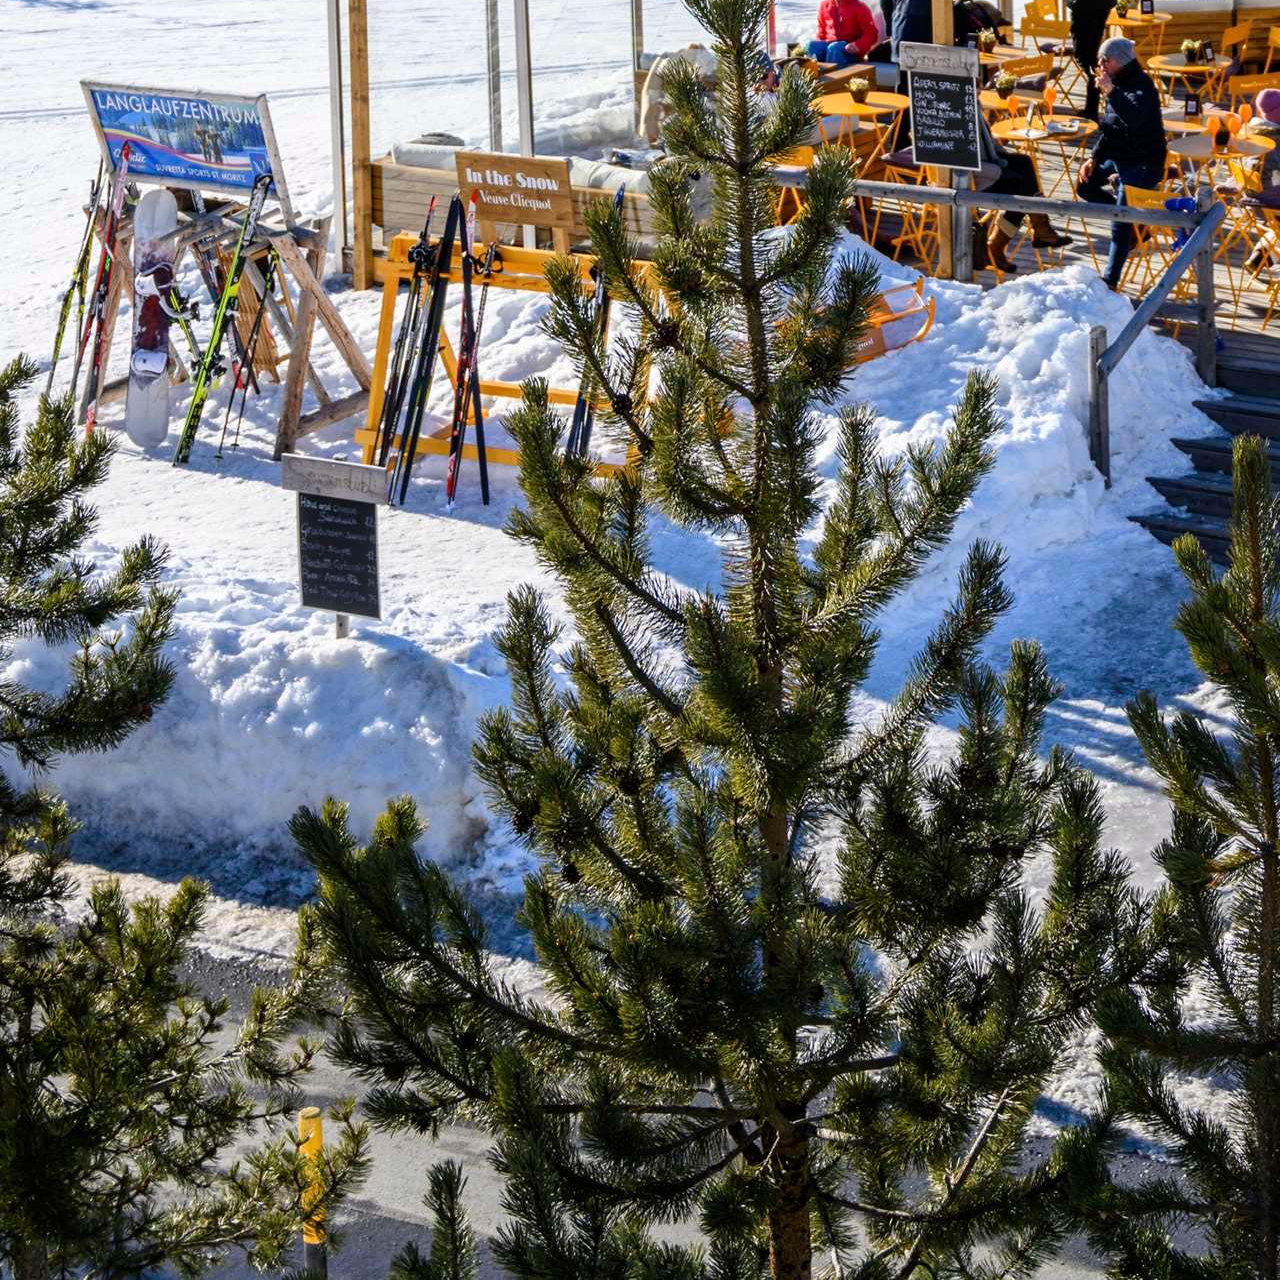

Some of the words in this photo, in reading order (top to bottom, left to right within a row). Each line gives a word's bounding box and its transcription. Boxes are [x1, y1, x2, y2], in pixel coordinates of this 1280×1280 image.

[96, 92, 260, 124] LANGLAUFZENTRUM
[188, 168, 211, 178] SPORTS
[222, 172, 246, 182] MORITZ
[466, 167, 483, 183] In
[485, 169, 513, 187] the
[516, 172, 559, 191] Snow
[480, 189, 509, 205] Veuve
[511, 192, 552, 211] Clicquot
